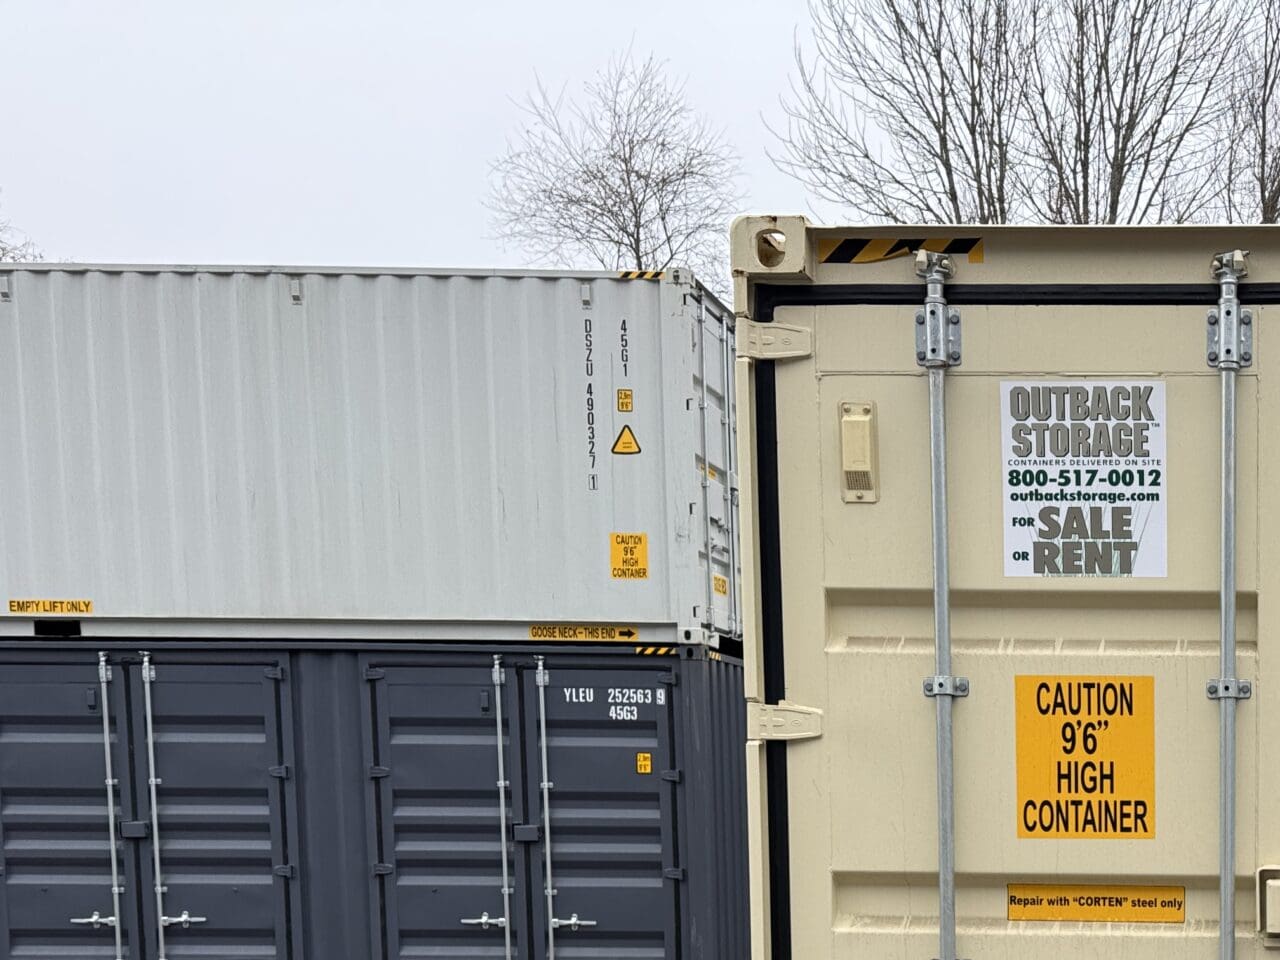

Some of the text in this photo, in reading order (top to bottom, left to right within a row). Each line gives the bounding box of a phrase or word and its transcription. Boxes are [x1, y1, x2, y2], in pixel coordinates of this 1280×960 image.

[584, 319, 593, 376] DSZU
[620, 319, 628, 377] 45G1
[1009, 386, 1155, 421] OUTBACK
[587, 383, 596, 469] 490327
[1011, 423, 1150, 457] STORAGE
[1008, 469, 1161, 487] 800-517-0012
[1010, 488, 1160, 504] outbackstorage.com
[1012, 506, 1132, 539] FOR SALE
[615, 535, 642, 545] CAUTION
[622, 558, 638, 567] HIGH
[1012, 541, 1138, 574] OR RENT
[612, 568, 648, 578] CONTAINER
[9, 600, 91, 613] EMPTY LIFT ONLY
[531, 626, 557, 638] GOOSE
[600, 627, 616, 639] END
[563, 688, 666, 705] YLEU 252563 9
[1036, 682, 1134, 716] CAUTION
[609, 705, 638, 720] 45G3
[1057, 761, 1115, 794] HIGH
[1023, 800, 1148, 833] CONTAINER
[1009, 895, 1044, 909] Repair
[1047, 896, 1070, 907] with
[1131, 897, 1158, 908] steel
[1160, 898, 1183, 911] only
